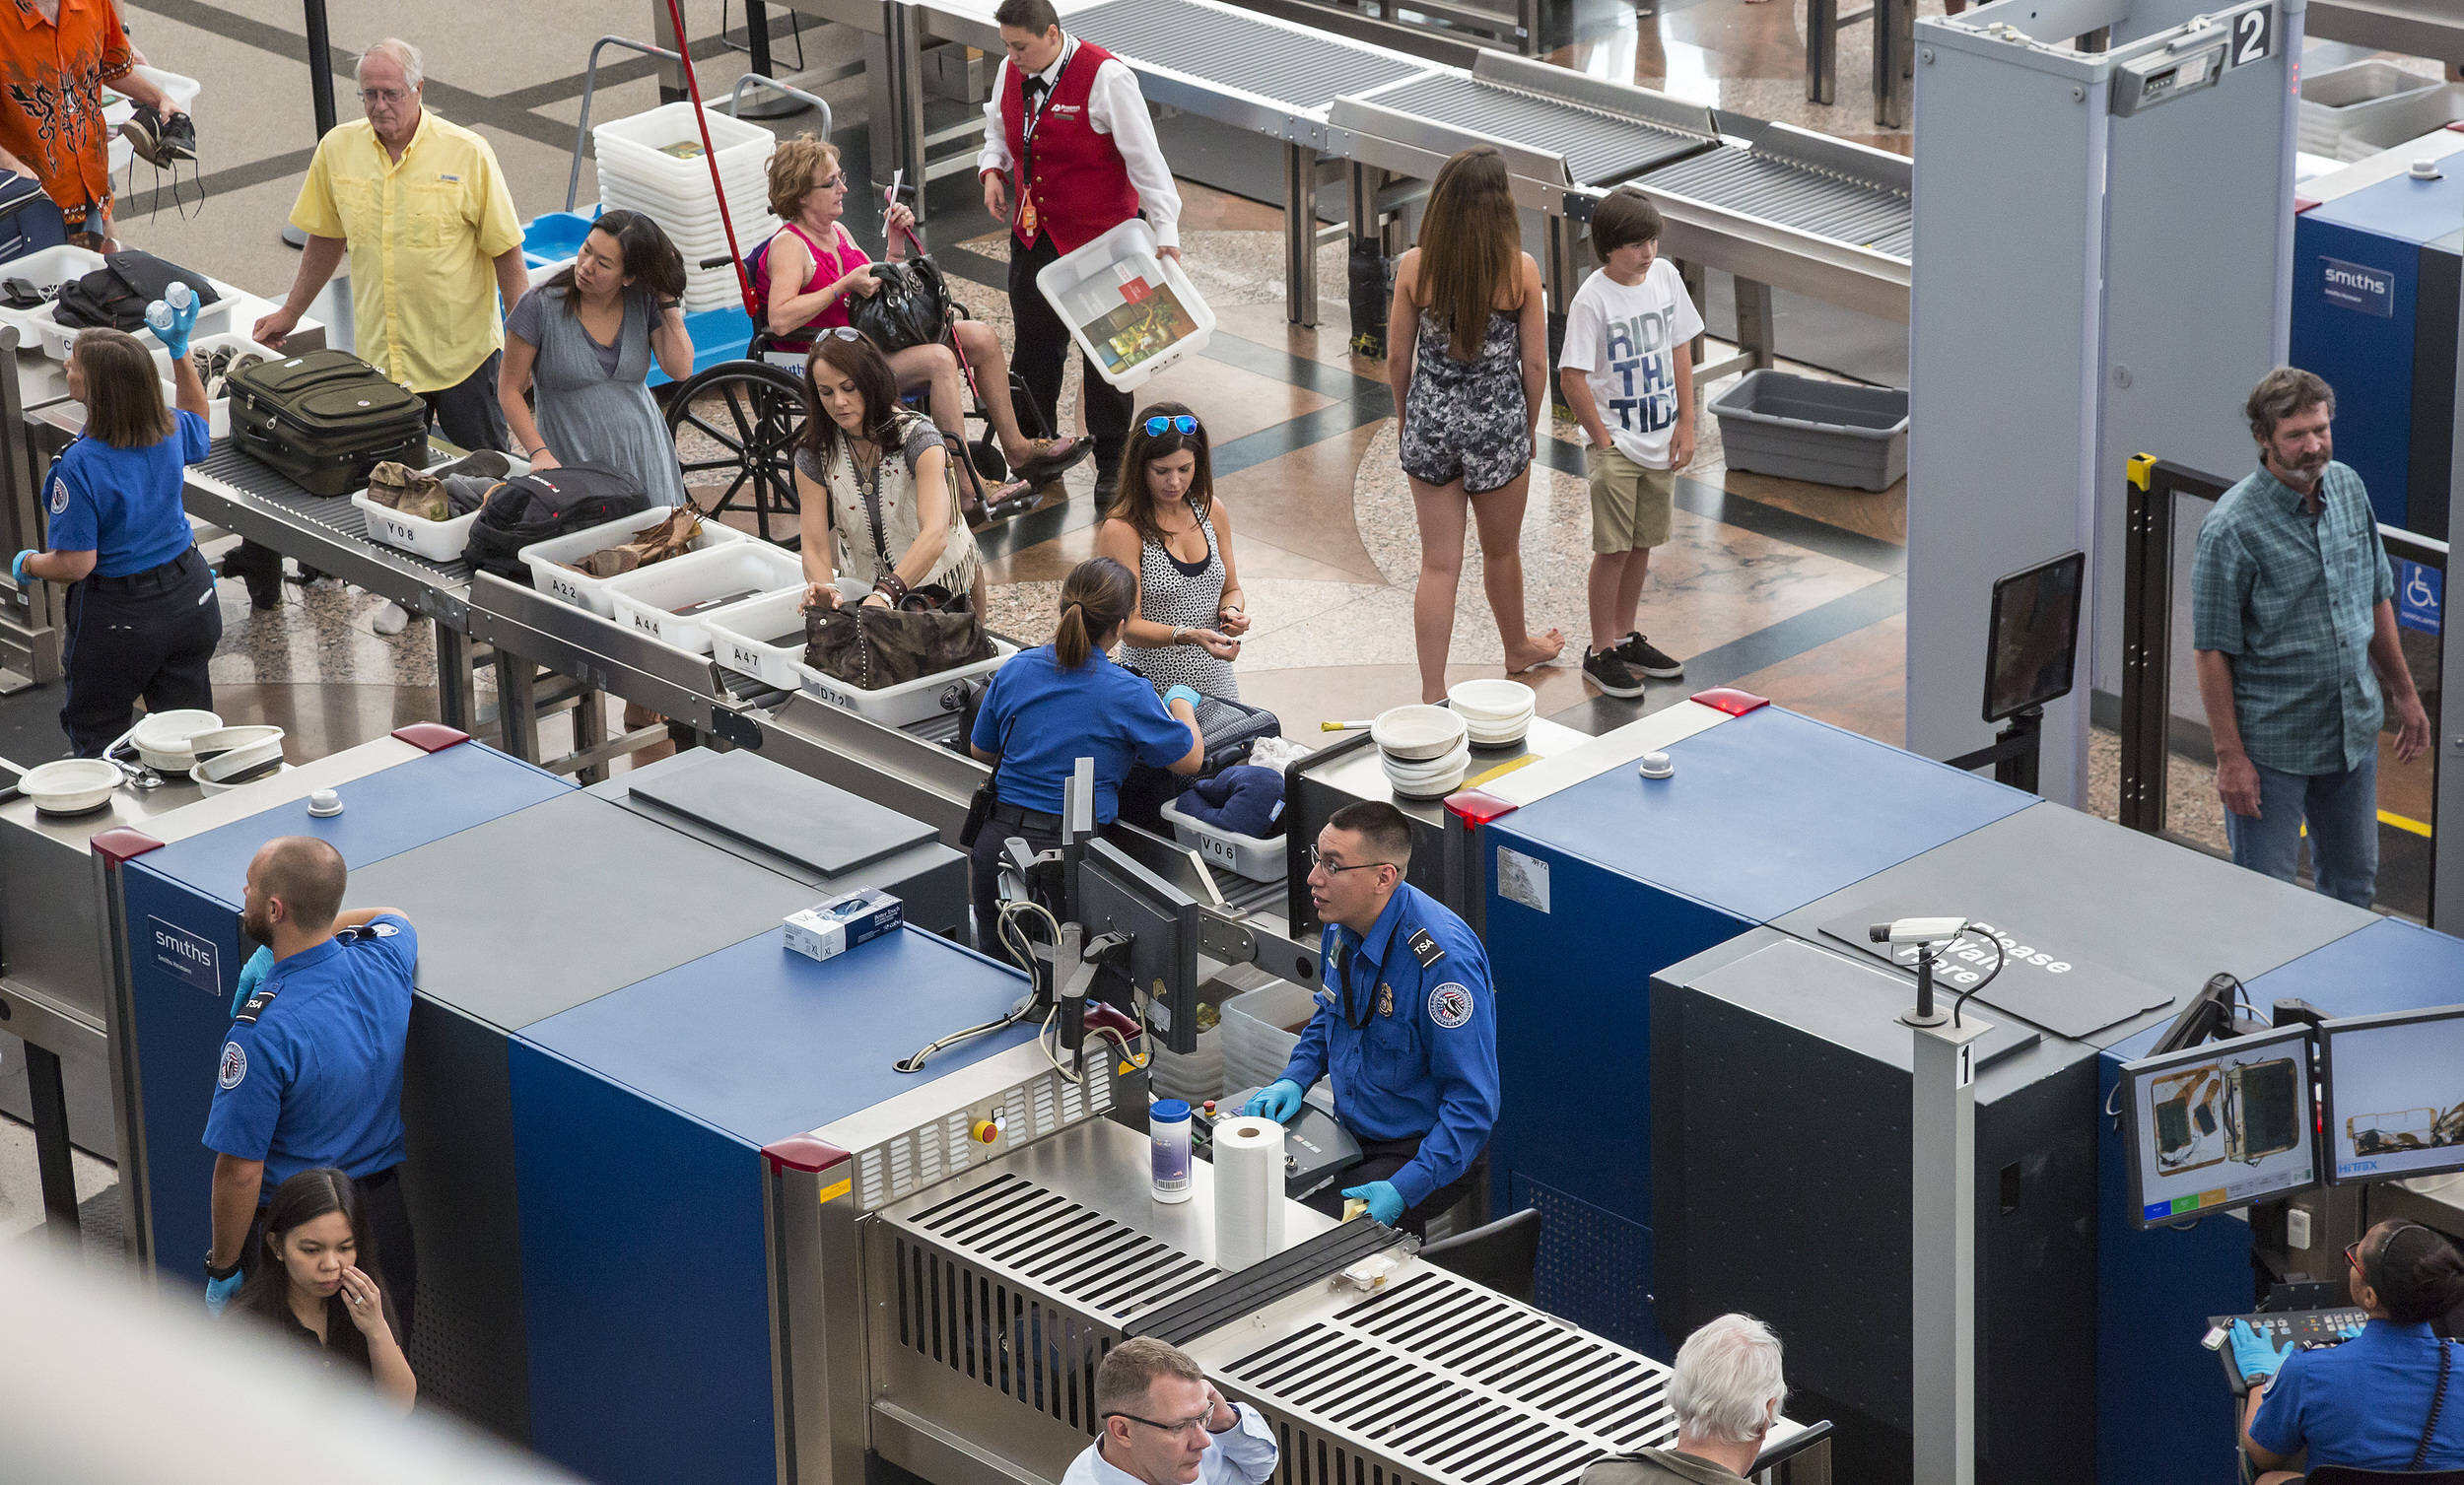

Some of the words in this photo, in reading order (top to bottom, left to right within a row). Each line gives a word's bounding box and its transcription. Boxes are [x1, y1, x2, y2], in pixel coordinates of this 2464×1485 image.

[2237, 9, 2265, 65] 2
[2325, 268, 2385, 295] smiths
[1608, 387, 1679, 434] TID
[155, 930, 211, 967] smiths
[1413, 938, 1435, 955] TSA
[245, 999, 263, 1009] TSA
[1961, 1045, 1970, 1085] 1
